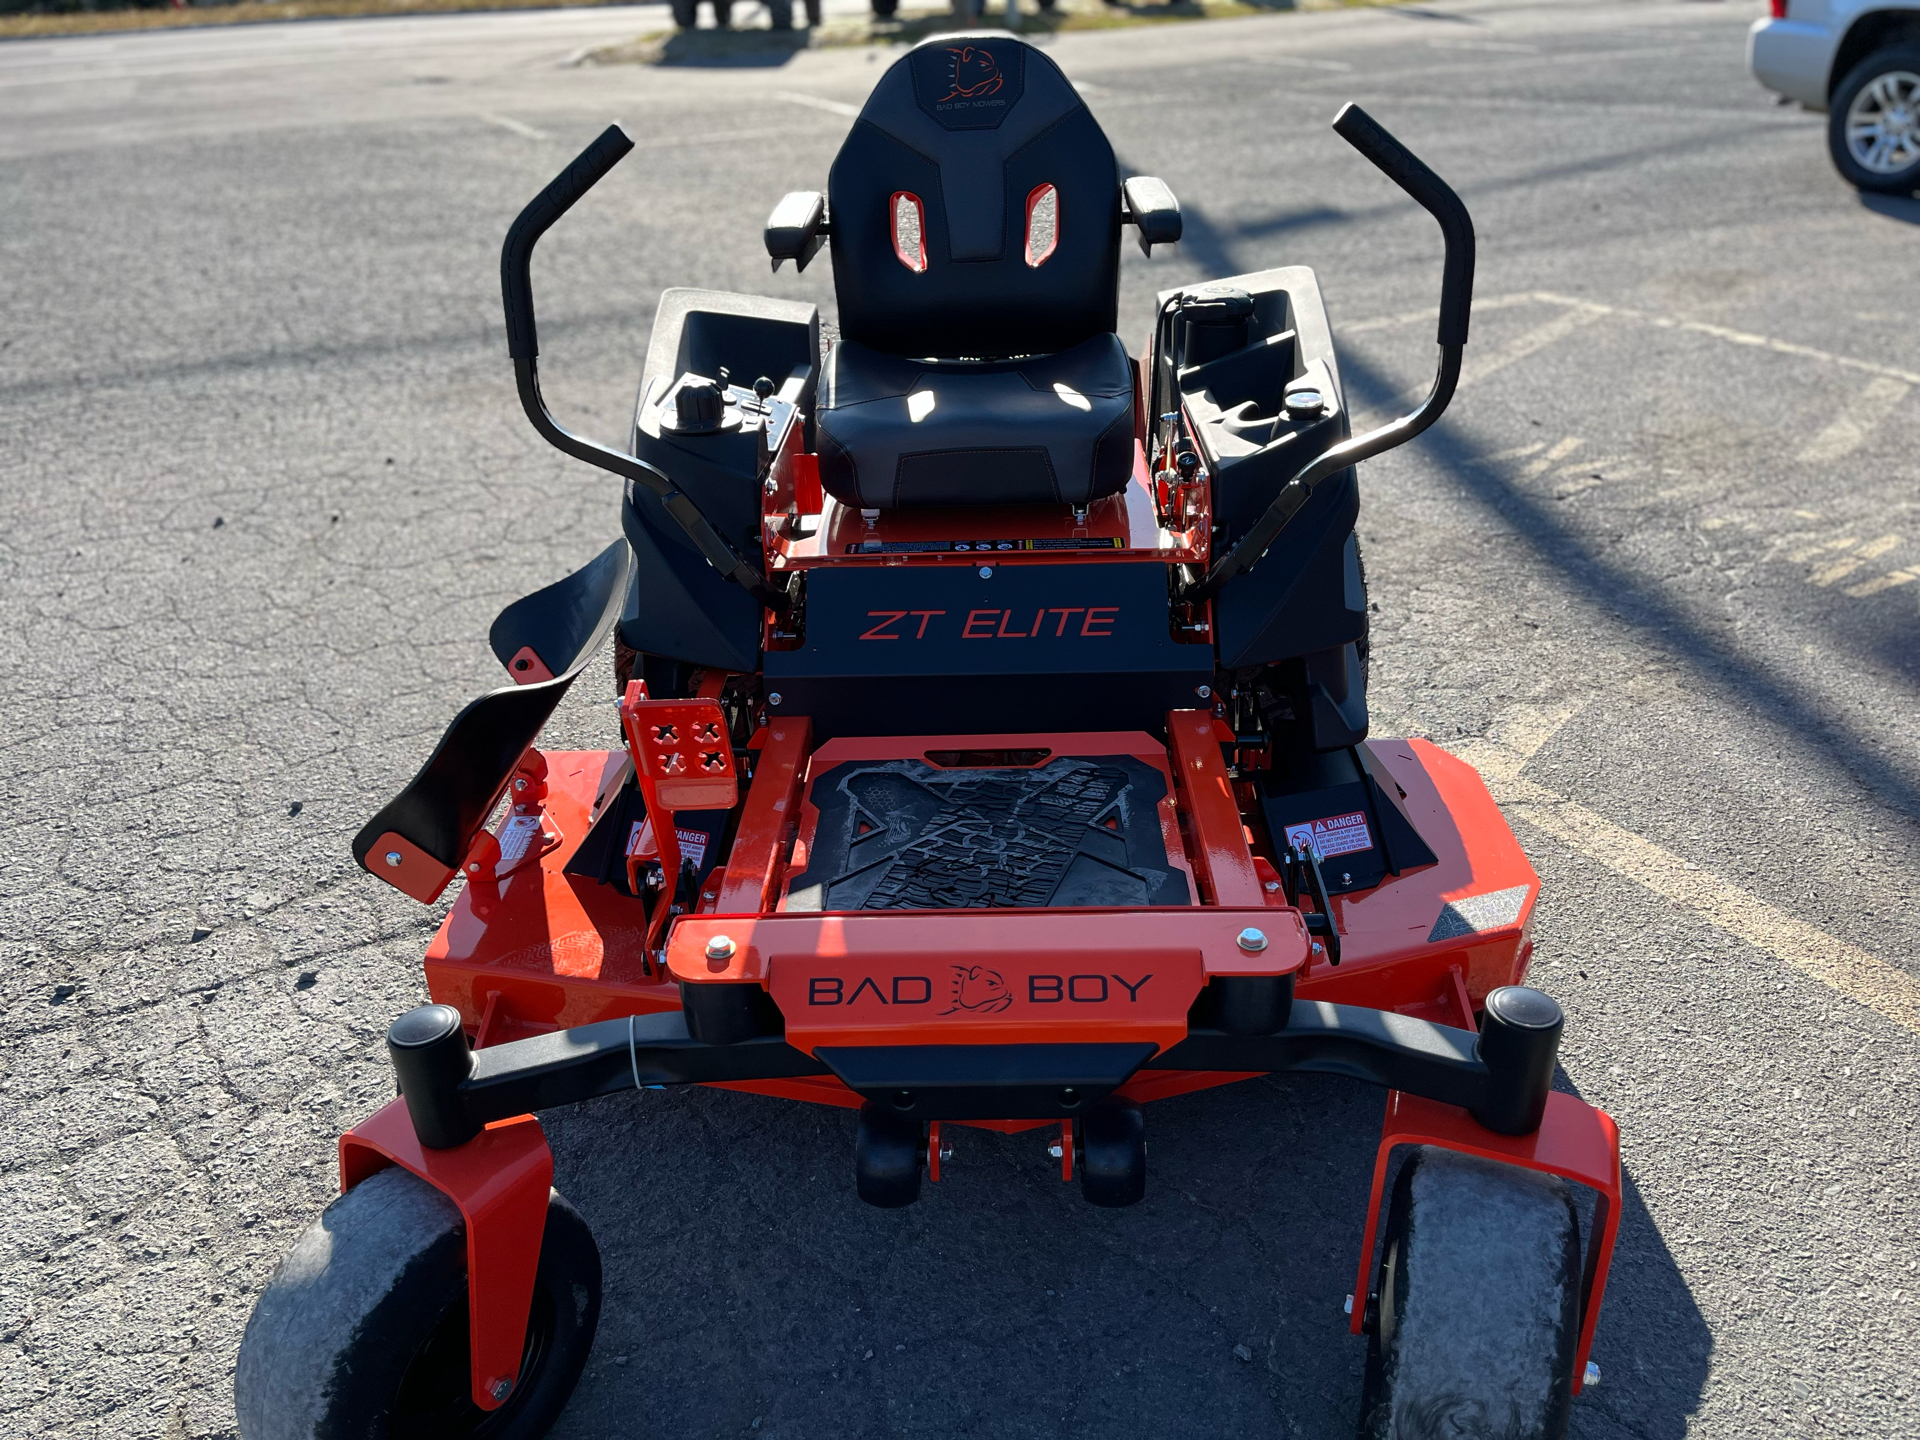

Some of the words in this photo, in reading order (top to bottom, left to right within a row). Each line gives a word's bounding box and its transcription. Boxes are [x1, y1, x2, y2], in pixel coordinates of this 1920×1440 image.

[973, 99, 1006, 107] MOWERS
[858, 610, 947, 640] ZT
[961, 607, 1120, 639] ELITE
[1327, 814, 1364, 829] DANGER
[808, 977, 932, 1006] BAD
[1028, 974, 1155, 1003] BOY
